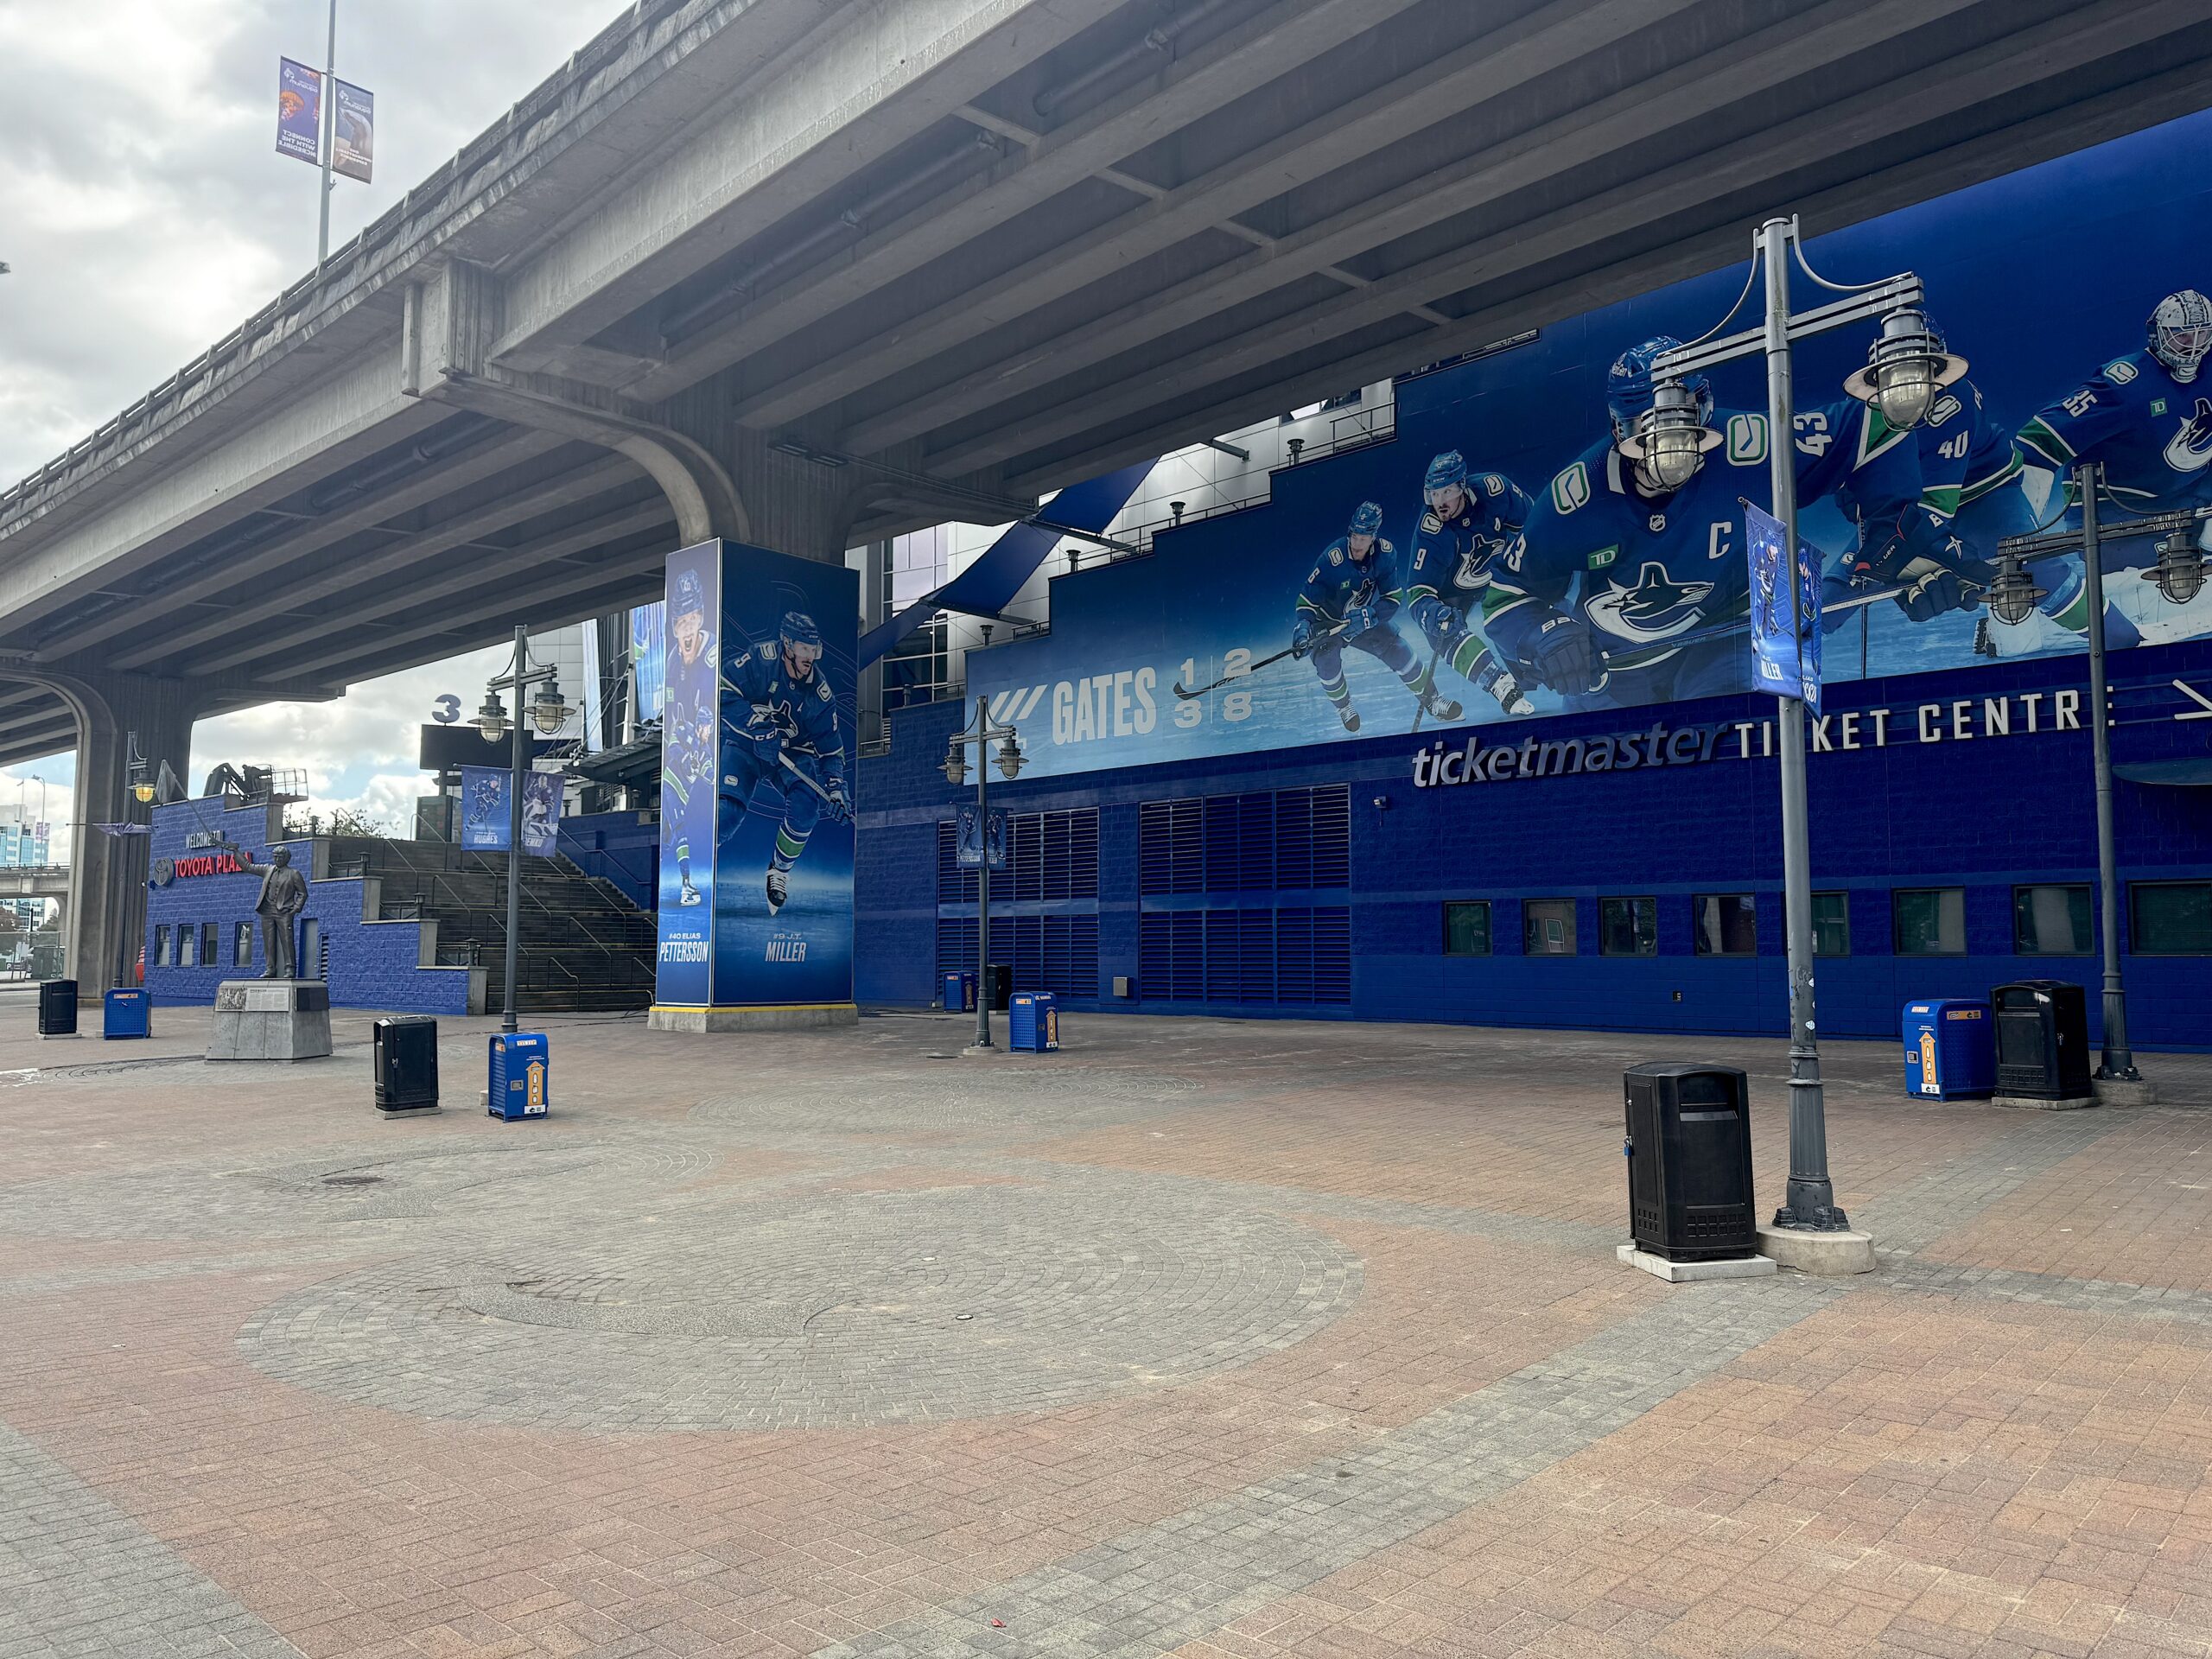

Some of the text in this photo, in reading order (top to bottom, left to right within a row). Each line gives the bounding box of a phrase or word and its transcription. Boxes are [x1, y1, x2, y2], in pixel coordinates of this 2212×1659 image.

[2063, 390, 2098, 417] 35
[1793, 412, 1832, 457] 43
[1937, 430, 1968, 459] 40
[1708, 521, 1732, 560] C
[1413, 548, 1427, 570] 9
[1591, 550, 1617, 566] TD
[1180, 647, 1252, 686] 1 2
[432, 694, 461, 724] 3
[1052, 666, 1157, 746] GATES
[1174, 692, 1252, 728] 3 8
[1411, 721, 1729, 788] ticketmaster
[1735, 709, 1891, 759] TIKET
[185, 831, 213, 849] WELCOME
[474, 834, 499, 844] HUGHES
[175, 855, 214, 878] TOYOTA
[659, 941, 709, 962] PETTERSSON
[766, 942, 807, 963] MILLER
